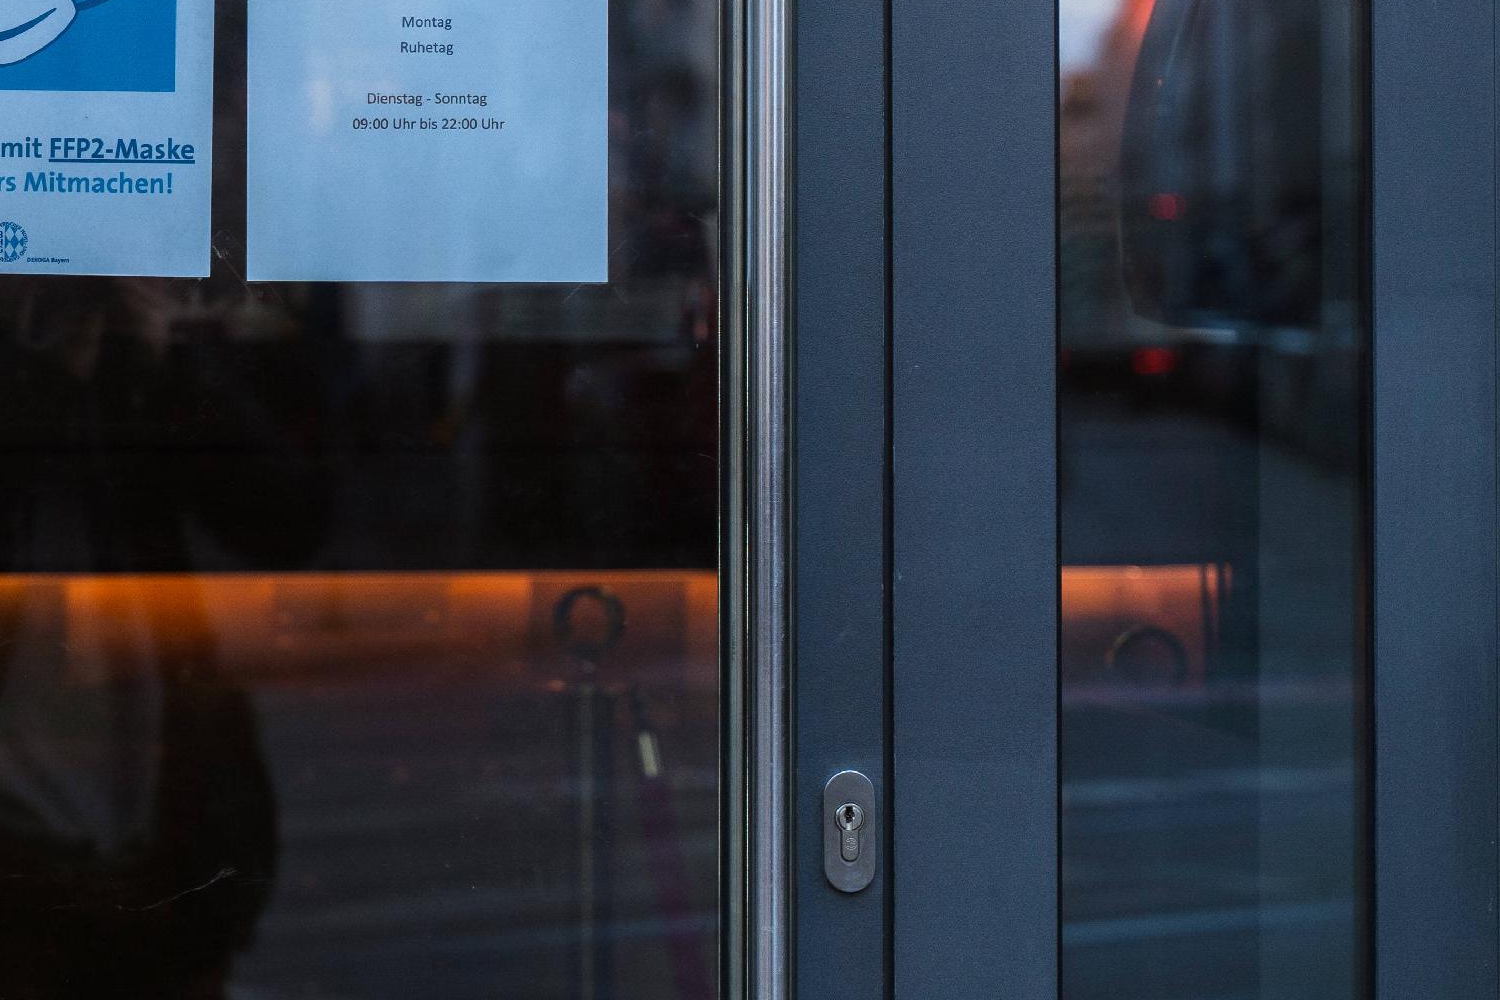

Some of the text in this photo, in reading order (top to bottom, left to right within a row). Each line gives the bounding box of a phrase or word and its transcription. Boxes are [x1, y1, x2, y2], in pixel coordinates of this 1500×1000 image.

[402, 17, 452, 30] Montag
[401, 42, 453, 55] Ruhetag
[368, 93, 422, 106] Dienstag
[435, 93, 487, 106] Sonntag
[353, 118, 505, 129] 09:00 Uhr bis 22:00 Uhr
[1, 137, 43, 159] mit
[49, 138, 195, 161] FFP2-Maske
[24, 171, 172, 194] Mitmachen!
